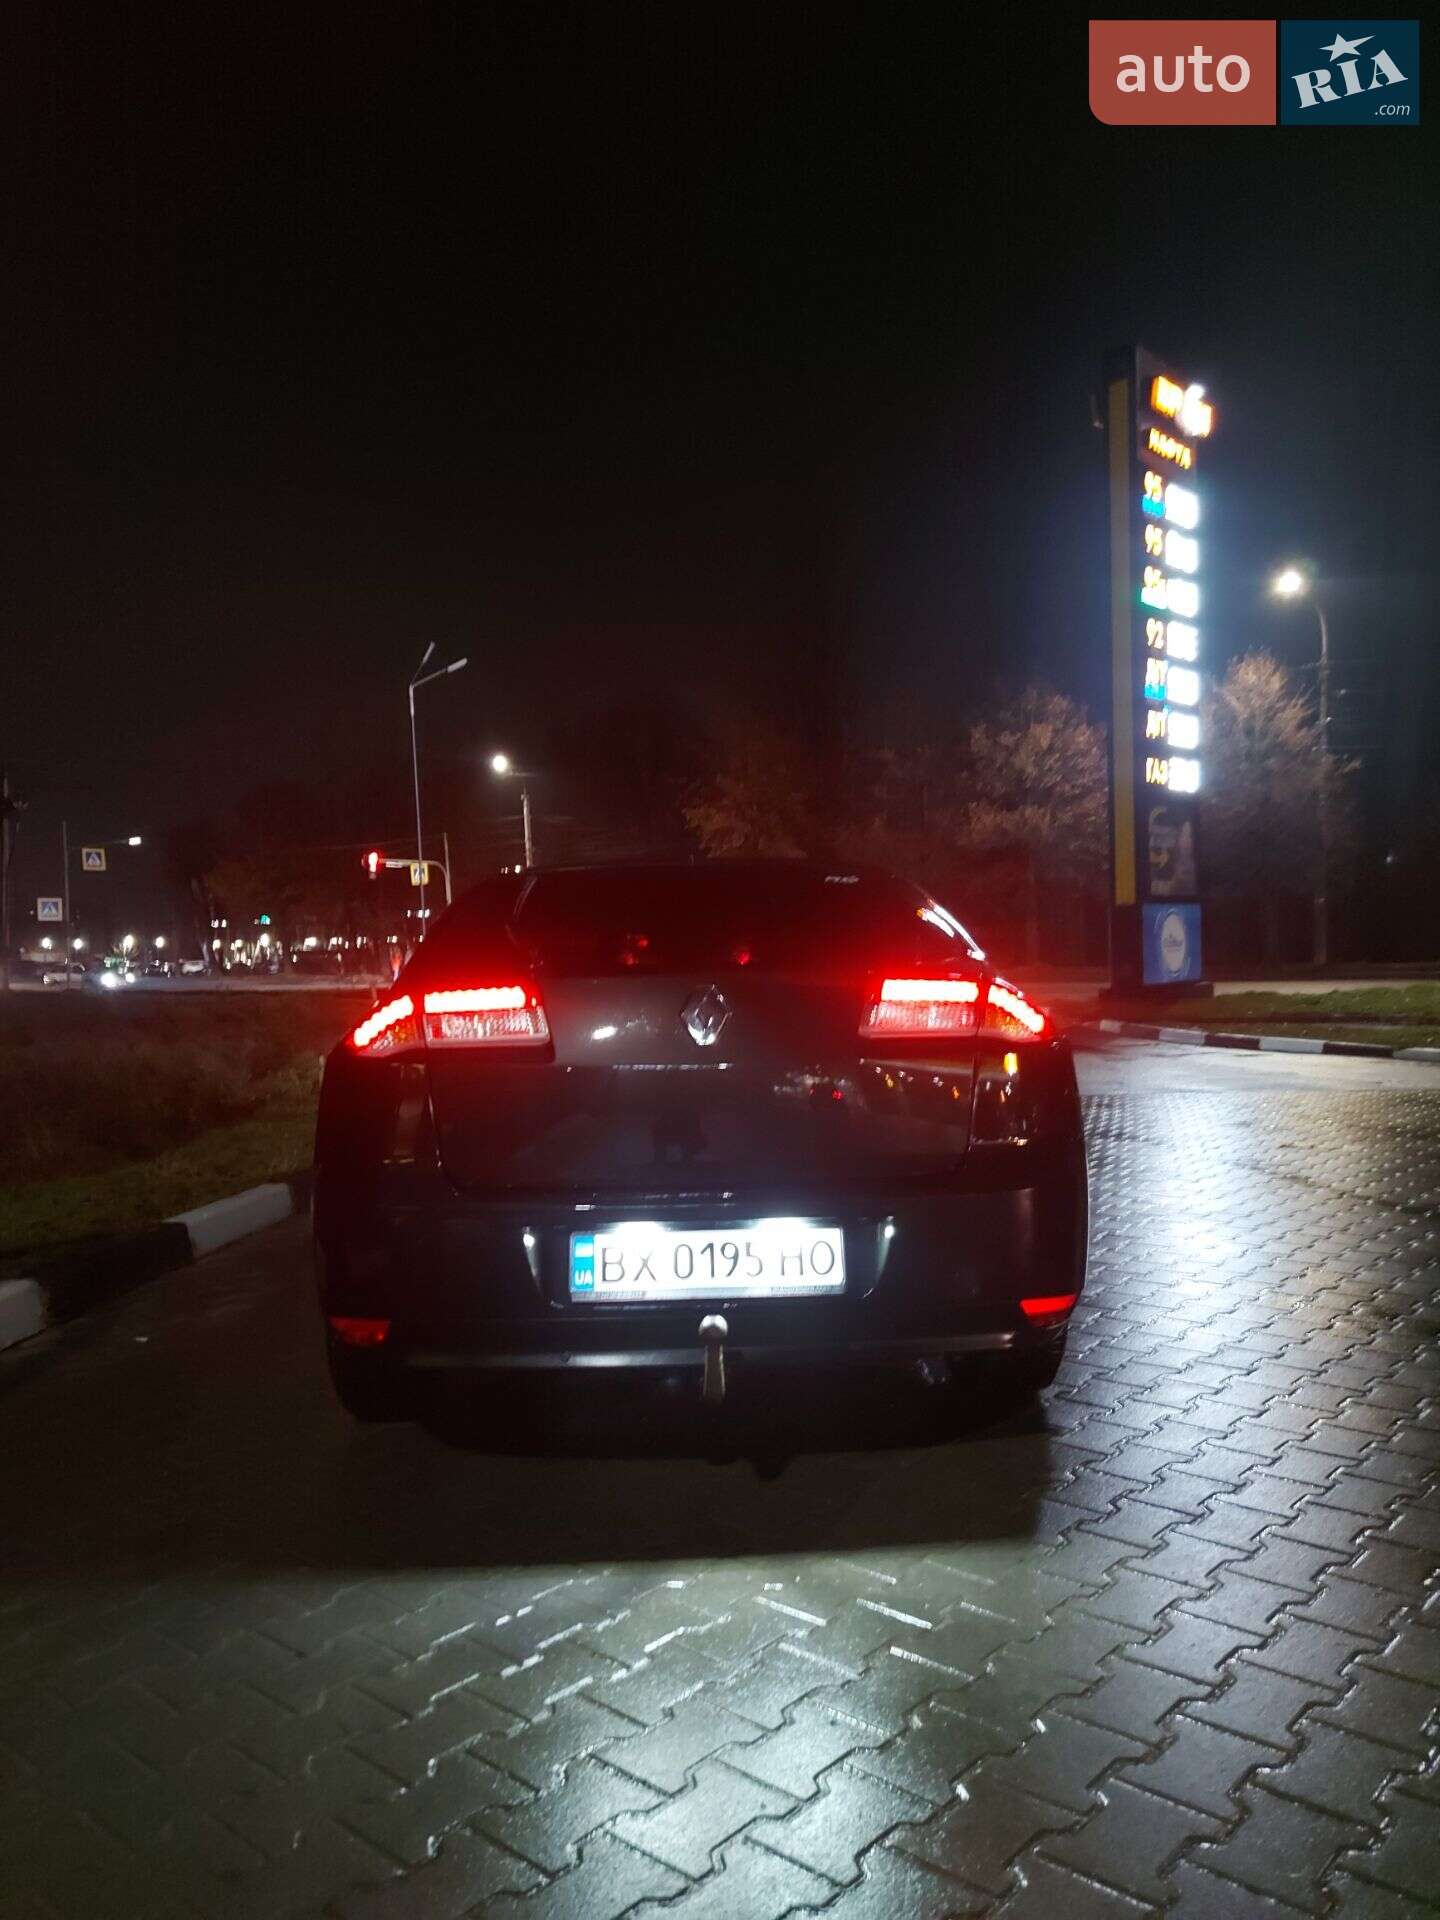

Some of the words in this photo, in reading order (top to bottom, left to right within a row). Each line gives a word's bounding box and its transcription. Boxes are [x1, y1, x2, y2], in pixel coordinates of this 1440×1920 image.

[1146, 618, 1163, 648] 92
[601, 1247, 657, 1282] BX
[674, 1242, 764, 1279] 0195
[779, 1240, 835, 1276] HO
[575, 1270, 593, 1286] UA
